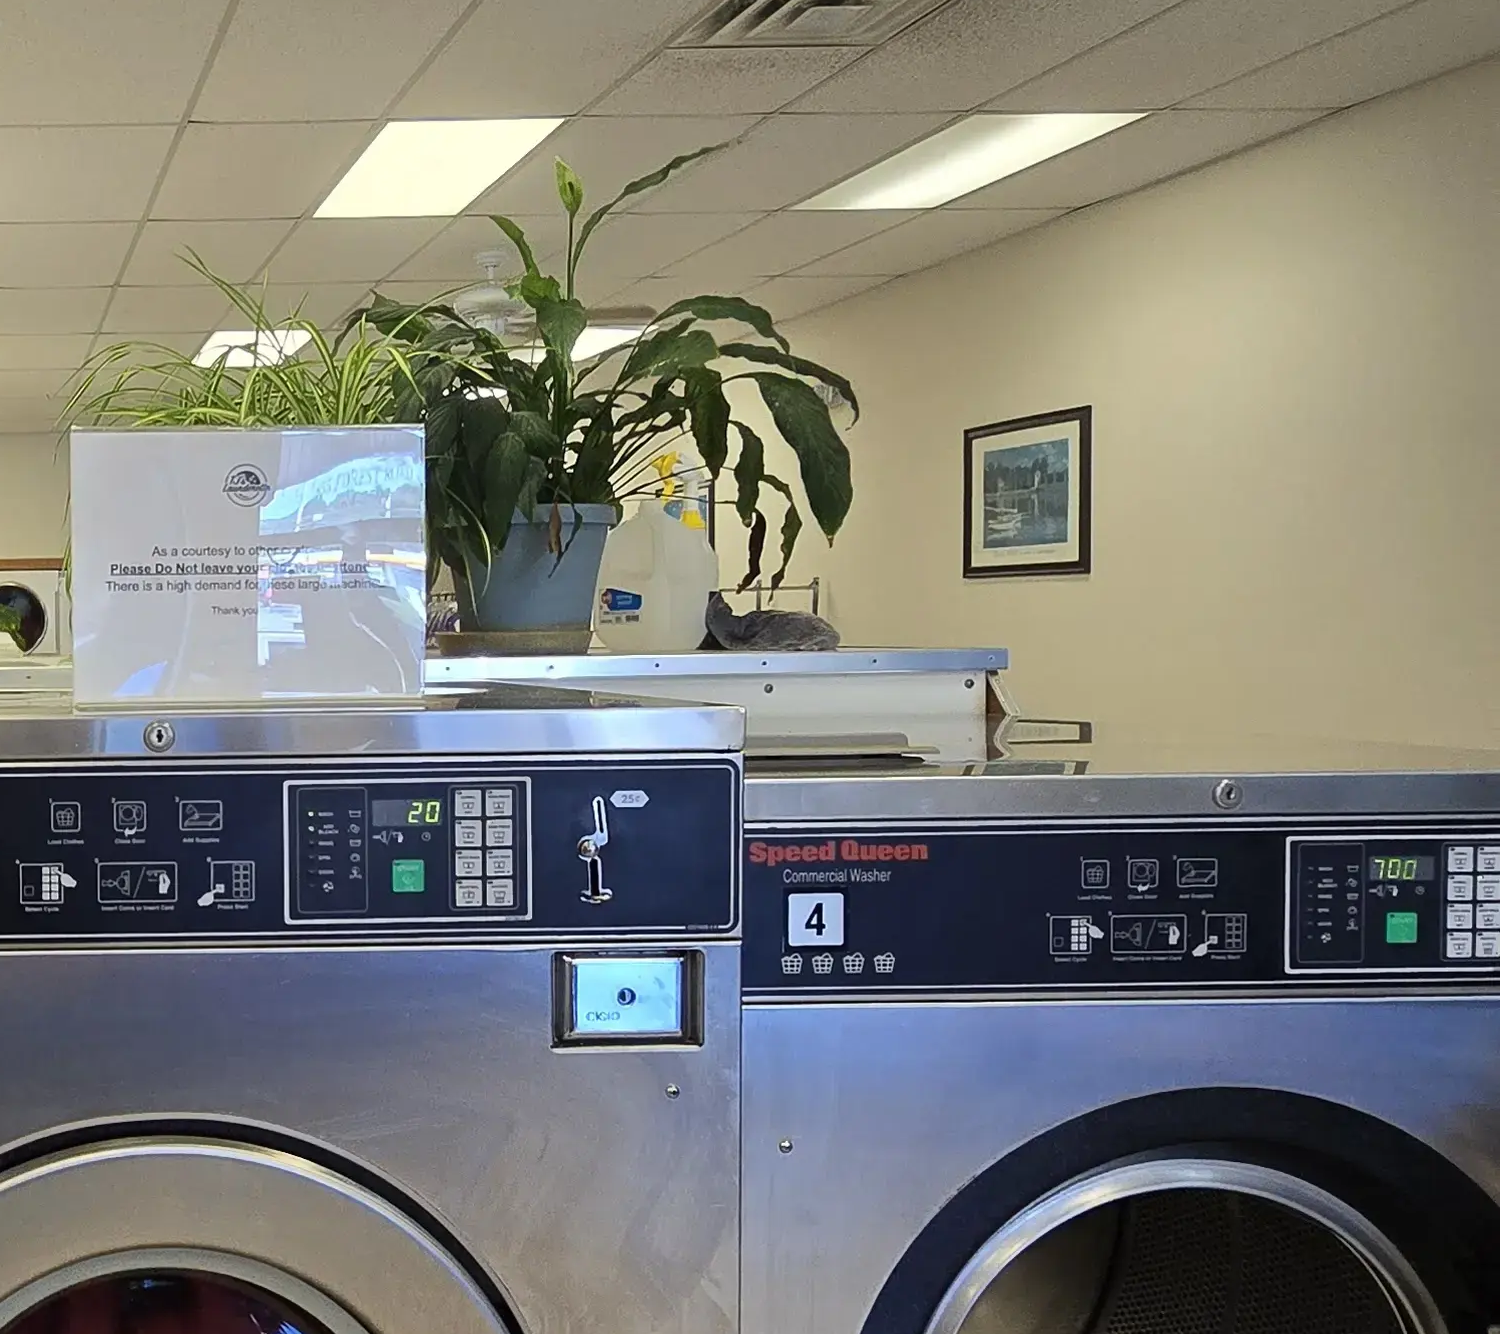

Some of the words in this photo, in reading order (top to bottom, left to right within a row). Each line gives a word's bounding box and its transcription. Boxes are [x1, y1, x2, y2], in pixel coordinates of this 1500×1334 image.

[152, 546, 167, 557] As
[171, 548, 178, 556] a
[181, 547, 231, 558] courtesy
[234, 546, 245, 556] to
[110, 564, 151, 575] Please
[155, 563, 173, 575] Do
[176, 563, 198, 575] Not
[201, 563, 233, 575] leave
[105, 581, 139, 591] There
[143, 580, 152, 591] is
[155, 582, 163, 591] a
[167, 579, 191, 593] high
[194, 579, 241, 590] demand
[245, 579, 260, 590] for
[211, 605, 239, 615] Thank
[407, 801, 440, 824] 20
[749, 841, 835, 866] Speed
[840, 840, 928, 861] Queen
[783, 869, 847, 884] Commercial
[849, 869, 891, 883] Washer
[1374, 858, 1417, 880] 700
[805, 902, 826, 936] 4
